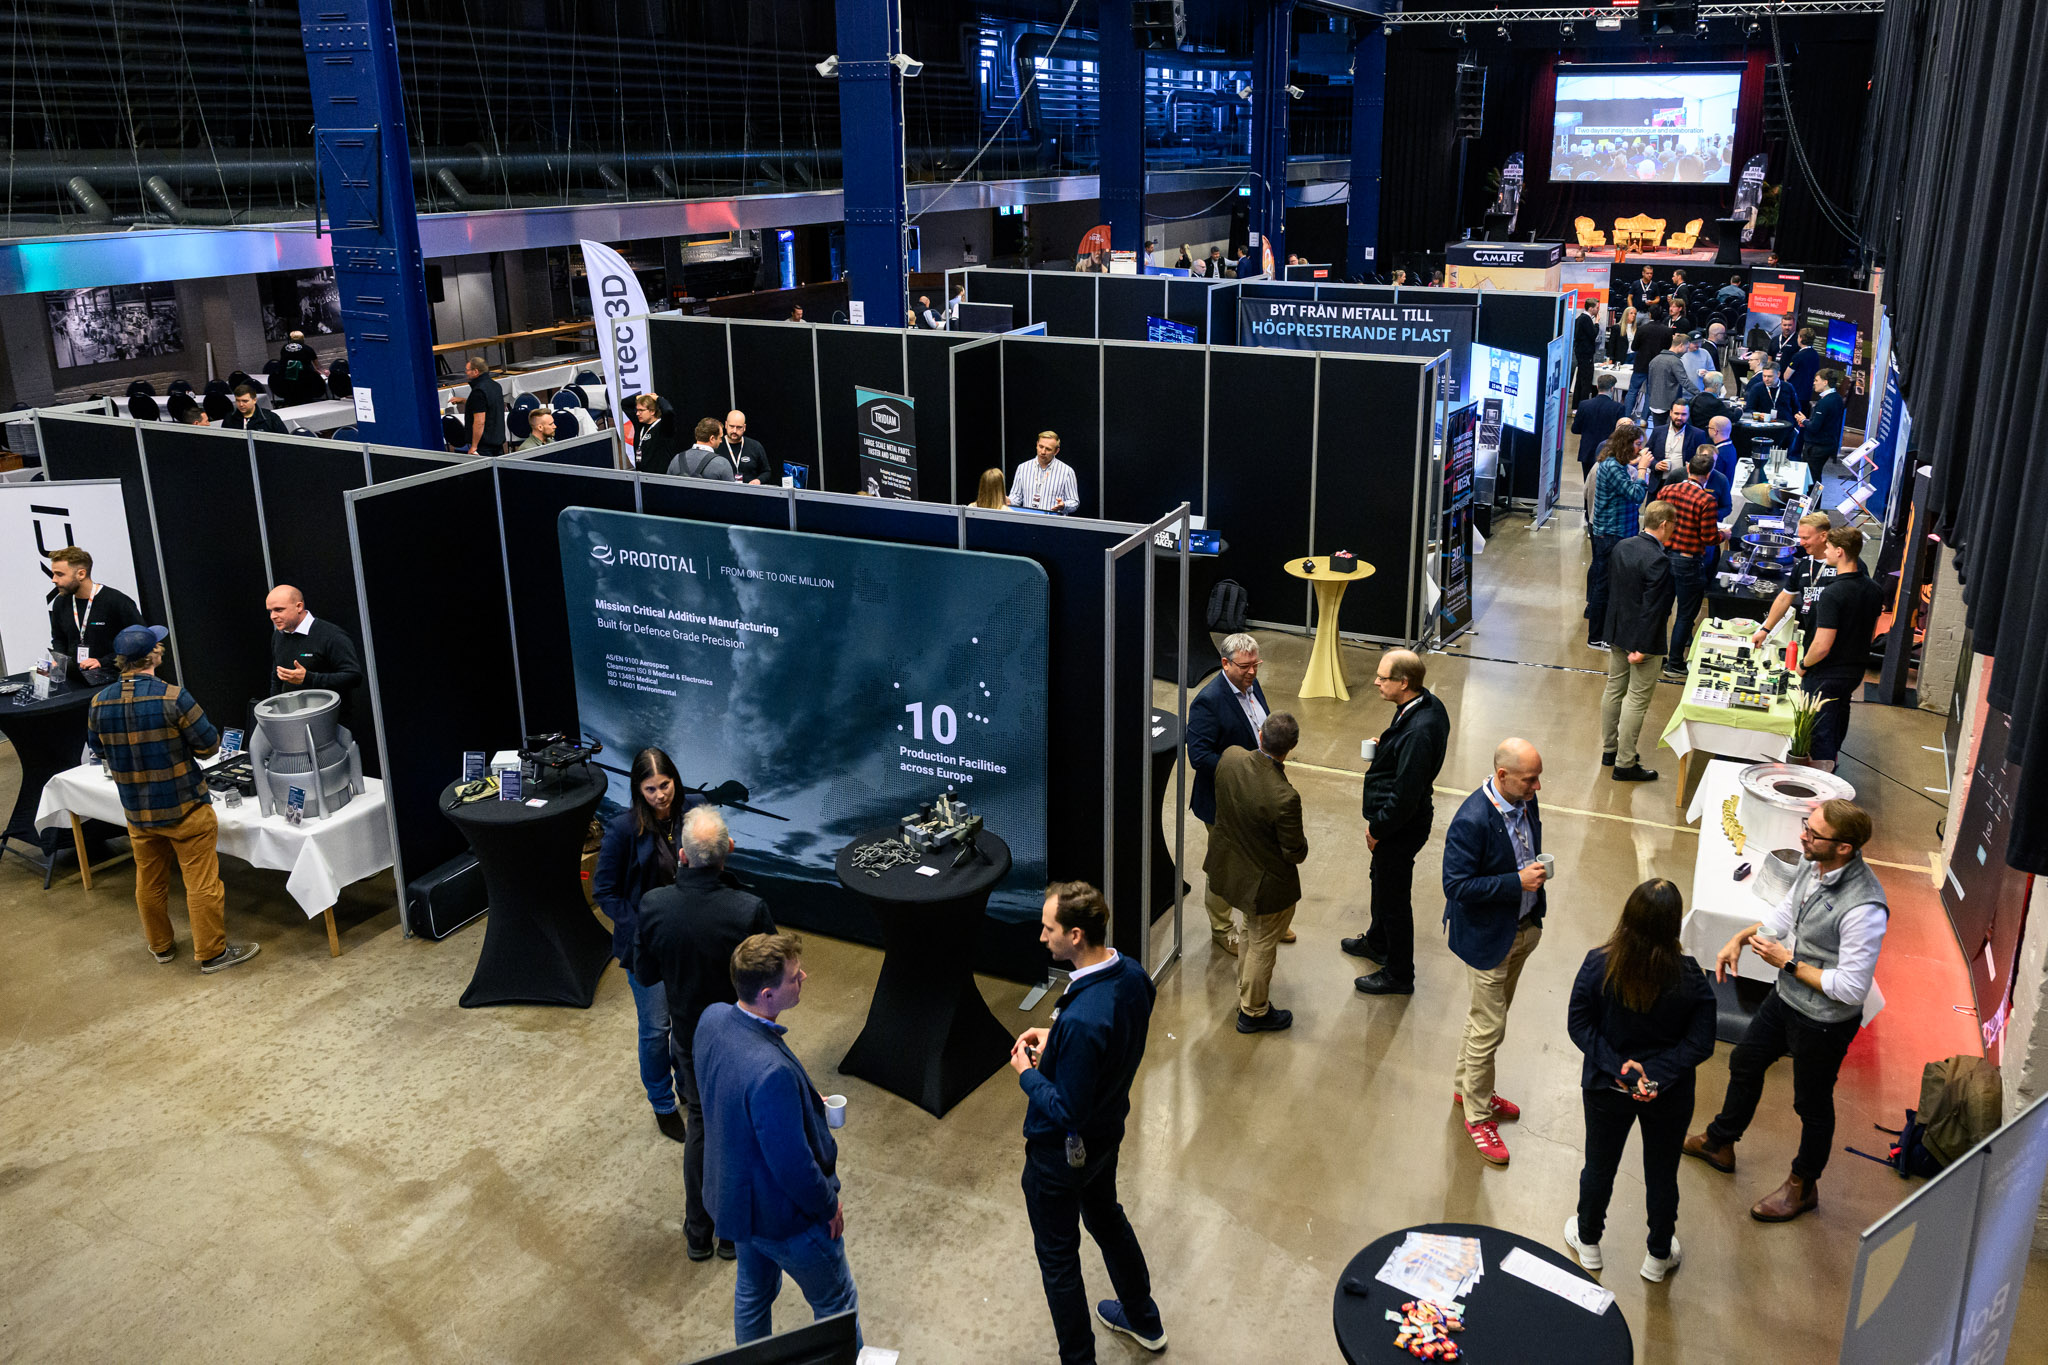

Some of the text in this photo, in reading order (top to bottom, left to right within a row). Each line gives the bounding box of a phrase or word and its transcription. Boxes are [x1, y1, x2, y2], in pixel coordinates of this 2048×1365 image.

[1270, 303, 1433, 322] BYT FRÅN METALL TILL
[1252, 319, 1451, 343] HÖGPRESTERANDE PLAST
[881, 450, 889, 459] AND
[619, 549, 697, 574] PROTOTAL
[720, 566, 835, 589] FROM ONE TO ONE MILLION
[595, 599, 779, 637] Mission Critical Additive Manufacturing
[597, 617, 745, 650] Built for Defence Grade Precision
[606, 654, 670, 671] AS/EN 9100 Aerospace
[606, 662, 636, 673] Cleanroom
[636, 666, 646, 675] ISO
[652, 670, 675, 680] Medical
[681, 675, 713, 686] Electronics
[607, 670, 658, 685] ISO 13485 Medical
[608, 679, 677, 697] ISO 14001 Environmental
[905, 701, 958, 745] 10
[900, 745, 1007, 774] Production Facilities
[900, 762, 973, 783] across Europe
